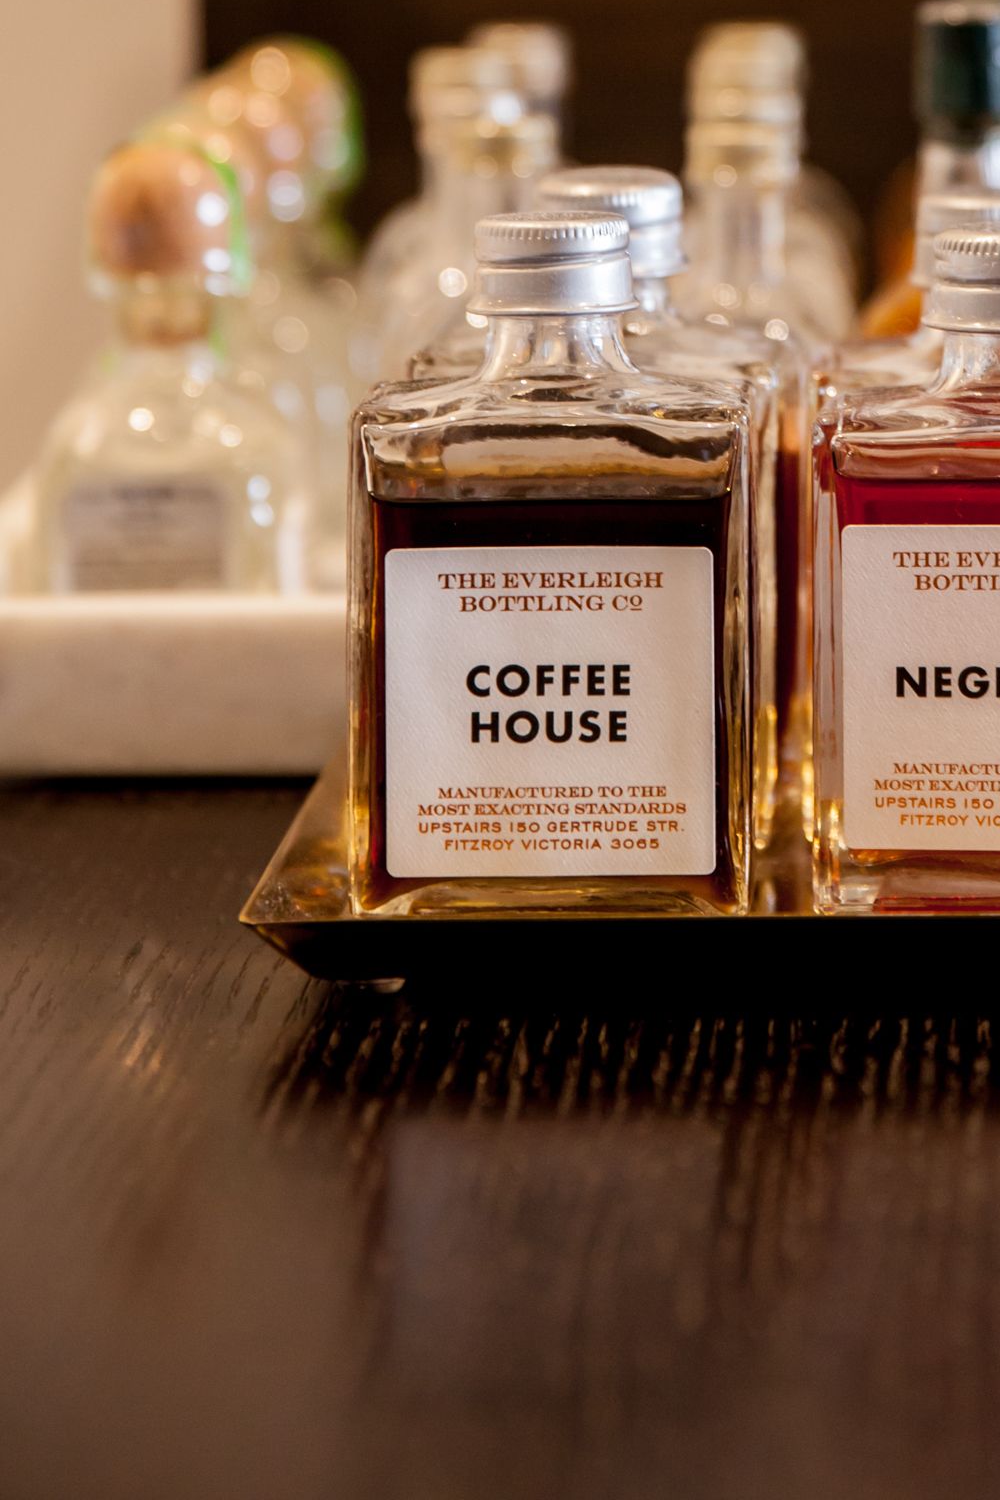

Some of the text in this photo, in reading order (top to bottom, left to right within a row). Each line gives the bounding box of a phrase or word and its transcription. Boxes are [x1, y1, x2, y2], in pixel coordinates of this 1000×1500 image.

[893, 552, 949, 569] THE
[438, 572, 663, 590] THE EVERLEIGH
[459, 595, 605, 613] BOTTLING
[465, 664, 631, 698] COFFEE
[471, 710, 627, 744] HOUSE
[438, 786, 666, 799] MANUFACTURED TO THE
[874, 779, 924, 793] MOST
[417, 802, 687, 816] MOST EXACTING STANDARDS
[875, 797, 956, 810] UPSTAIRS
[964, 797, 994, 810] 150
[418, 820, 684, 834] UPSTAIRS 150 GERTRUDE STR.
[900, 814, 968, 828] FITZROY
[444, 837, 659, 851] FITZROY VICTORIA 3065
